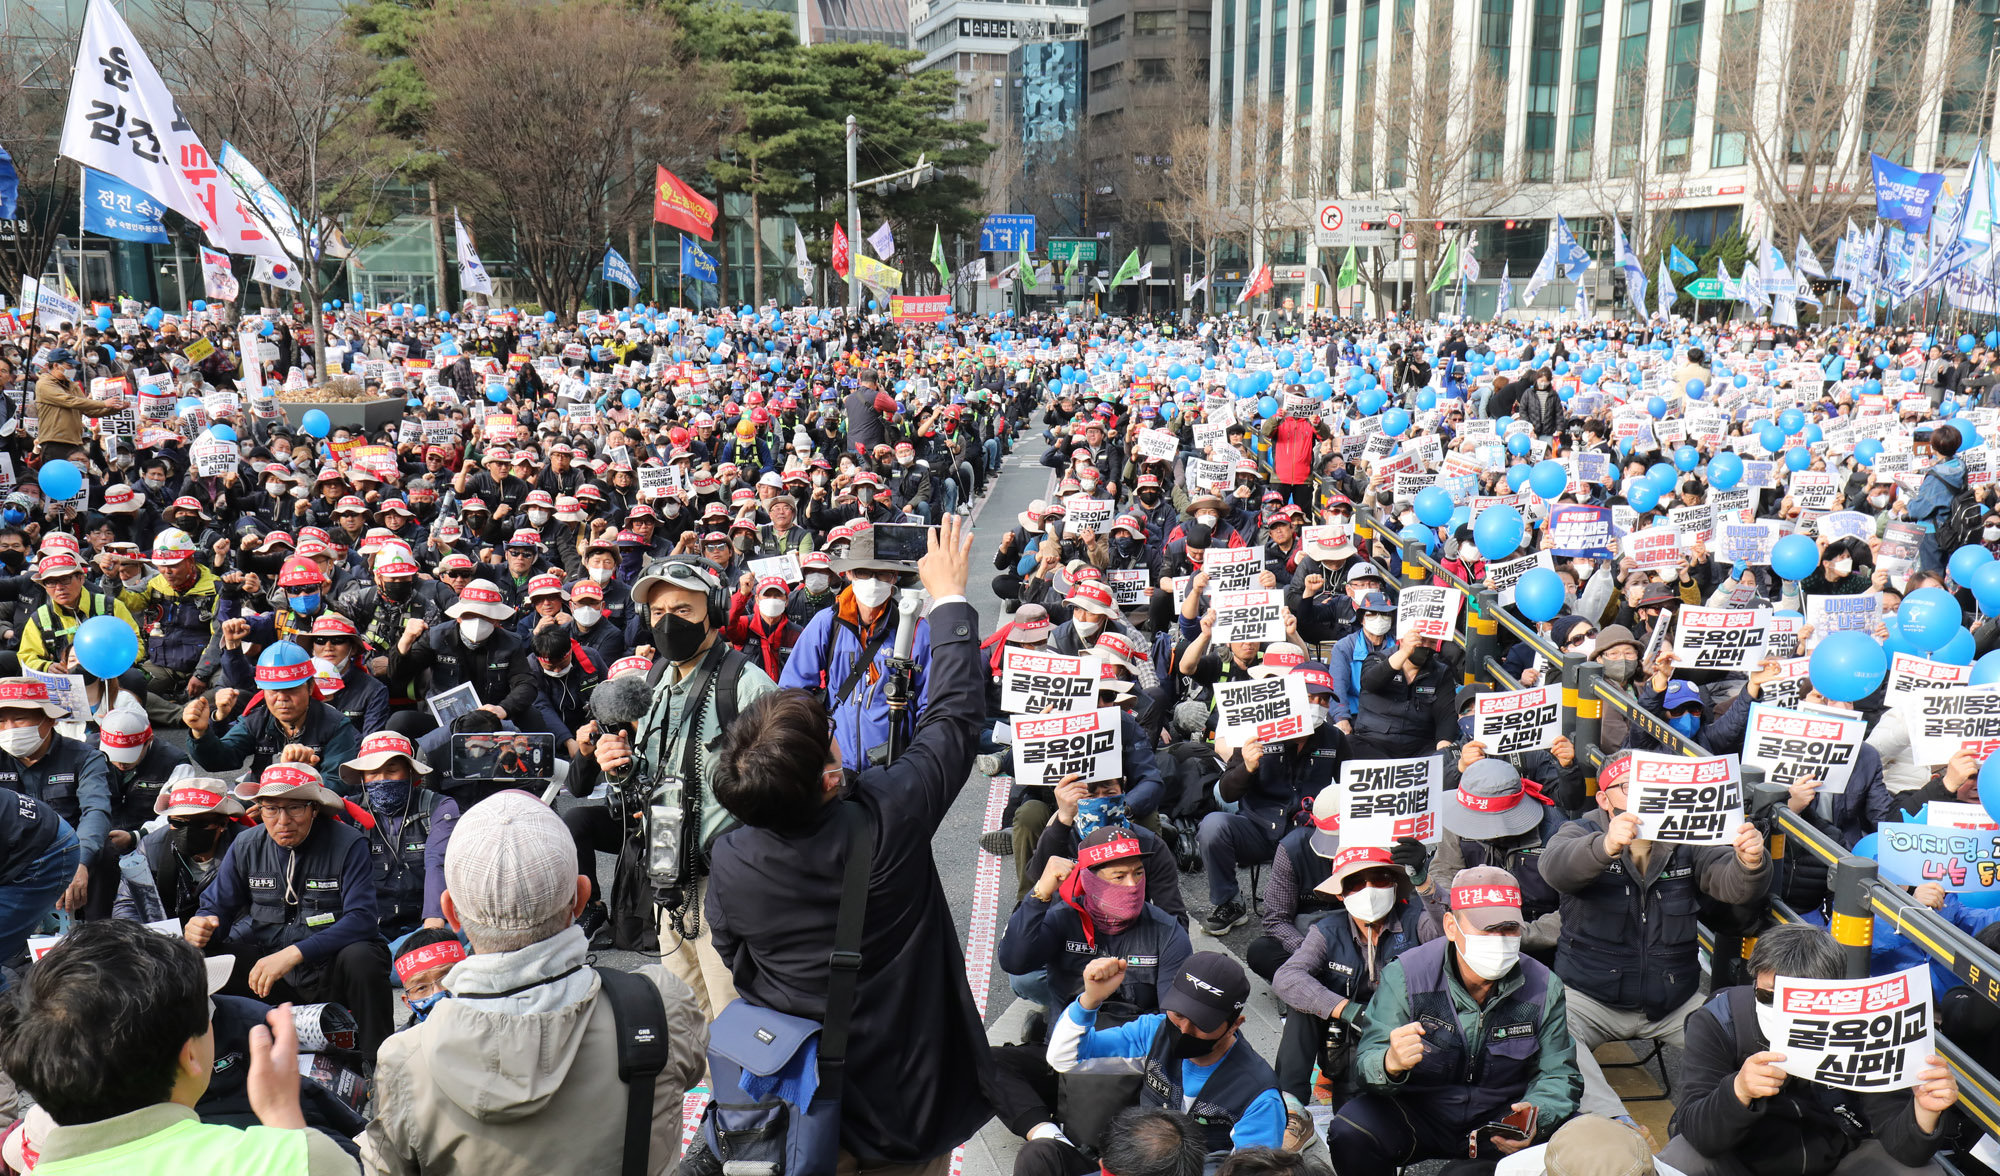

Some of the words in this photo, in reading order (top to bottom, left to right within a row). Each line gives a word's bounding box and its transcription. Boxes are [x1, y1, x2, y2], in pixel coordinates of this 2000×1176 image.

[98, 46, 134, 93] 윤
[86, 100, 169, 166] 김건
[98, 189, 132, 214] 전진
[200, 454, 236, 465] 굴욕외교
[208, 463, 229, 474] 심판!
[1200, 464, 1229, 472] 강제동원
[641, 469, 671, 478] 강제동원
[642, 477, 673, 488] 굴욕해법
[1397, 476, 1436, 485] 강제동원
[656, 485, 678, 496] 무효!
[1794, 485, 1835, 496] 굴욕외교
[1801, 496, 1826, 506] 심판!
[1069, 511, 1111, 524] 굴욕외교
[1674, 507, 1711, 522] 강제동원
[1634, 533, 1675, 547] 김건희를
[1727, 525, 1769, 538] 이재명과
[1635, 549, 1679, 563] 특검하라!
[1208, 560, 1261, 580] 굴욕외교
[1490, 554, 1539, 581] 강제동원
[1401, 588, 1447, 607] 강제동원
[1825, 597, 1876, 612] 이재명과
[1218, 605, 1280, 626] 굴욕외교
[1401, 601, 1444, 623] 굴욕해법
[1838, 614, 1865, 629] 나는
[1230, 623, 1266, 641] 심판!
[1683, 628, 1762, 649] 굴욕외교
[1010, 655, 1048, 671] 윤석열
[1050, 658, 1079, 674] 정부
[1695, 648, 1743, 667] 심판!
[258, 667, 275, 680] 단결
[291, 661, 309, 674] 투쟁
[1011, 672, 1094, 697] 굴욕외교
[1220, 679, 1286, 707] 강제동원
[1480, 694, 1516, 715] 윤석열
[1519, 689, 1546, 708] 정부
[1225, 702, 1291, 726] 굴욕해법
[1482, 704, 1558, 735] 굴욕외교
[1017, 720, 1064, 737] 윤석열
[1065, 714, 1098, 734] 정부
[1256, 716, 1303, 743] 무효!
[1758, 714, 1803, 734] 윤석열
[1806, 720, 1843, 740] 정부
[1925, 718, 2000, 737] 굴욕해법
[1023, 730, 1115, 763] 굴욕외교
[1498, 730, 1542, 754] 심판!
[1758, 736, 1855, 766] 굴욕외교
[283, 768, 308, 785] 투쟁
[1043, 757, 1096, 784] 심판!
[1348, 761, 1430, 792] 강제동원
[1638, 762, 1695, 783] 윤석열
[1697, 759, 1728, 781] 정부
[185, 792, 210, 804] 투쟁
[1349, 790, 1430, 819] 굴욕해법
[1465, 790, 1489, 809] 투쟁
[1639, 782, 1741, 814] 굴욕외교
[1391, 813, 1436, 843] 무효!
[1657, 809, 1725, 842] 심판!
[1090, 845, 1115, 862] 단결
[1345, 848, 1369, 861] 투쟁
[1922, 857, 1967, 886] 나는
[1458, 889, 1483, 905] 단결
[396, 953, 418, 971] 단결
[435, 942, 460, 961] 투쟁
[1787, 988, 1864, 1012] 윤석열
[1866, 979, 1906, 1011] 정부
[1787, 1002, 1927, 1052] 굴욕외교
[1814, 1048, 1906, 1087] 심판!
